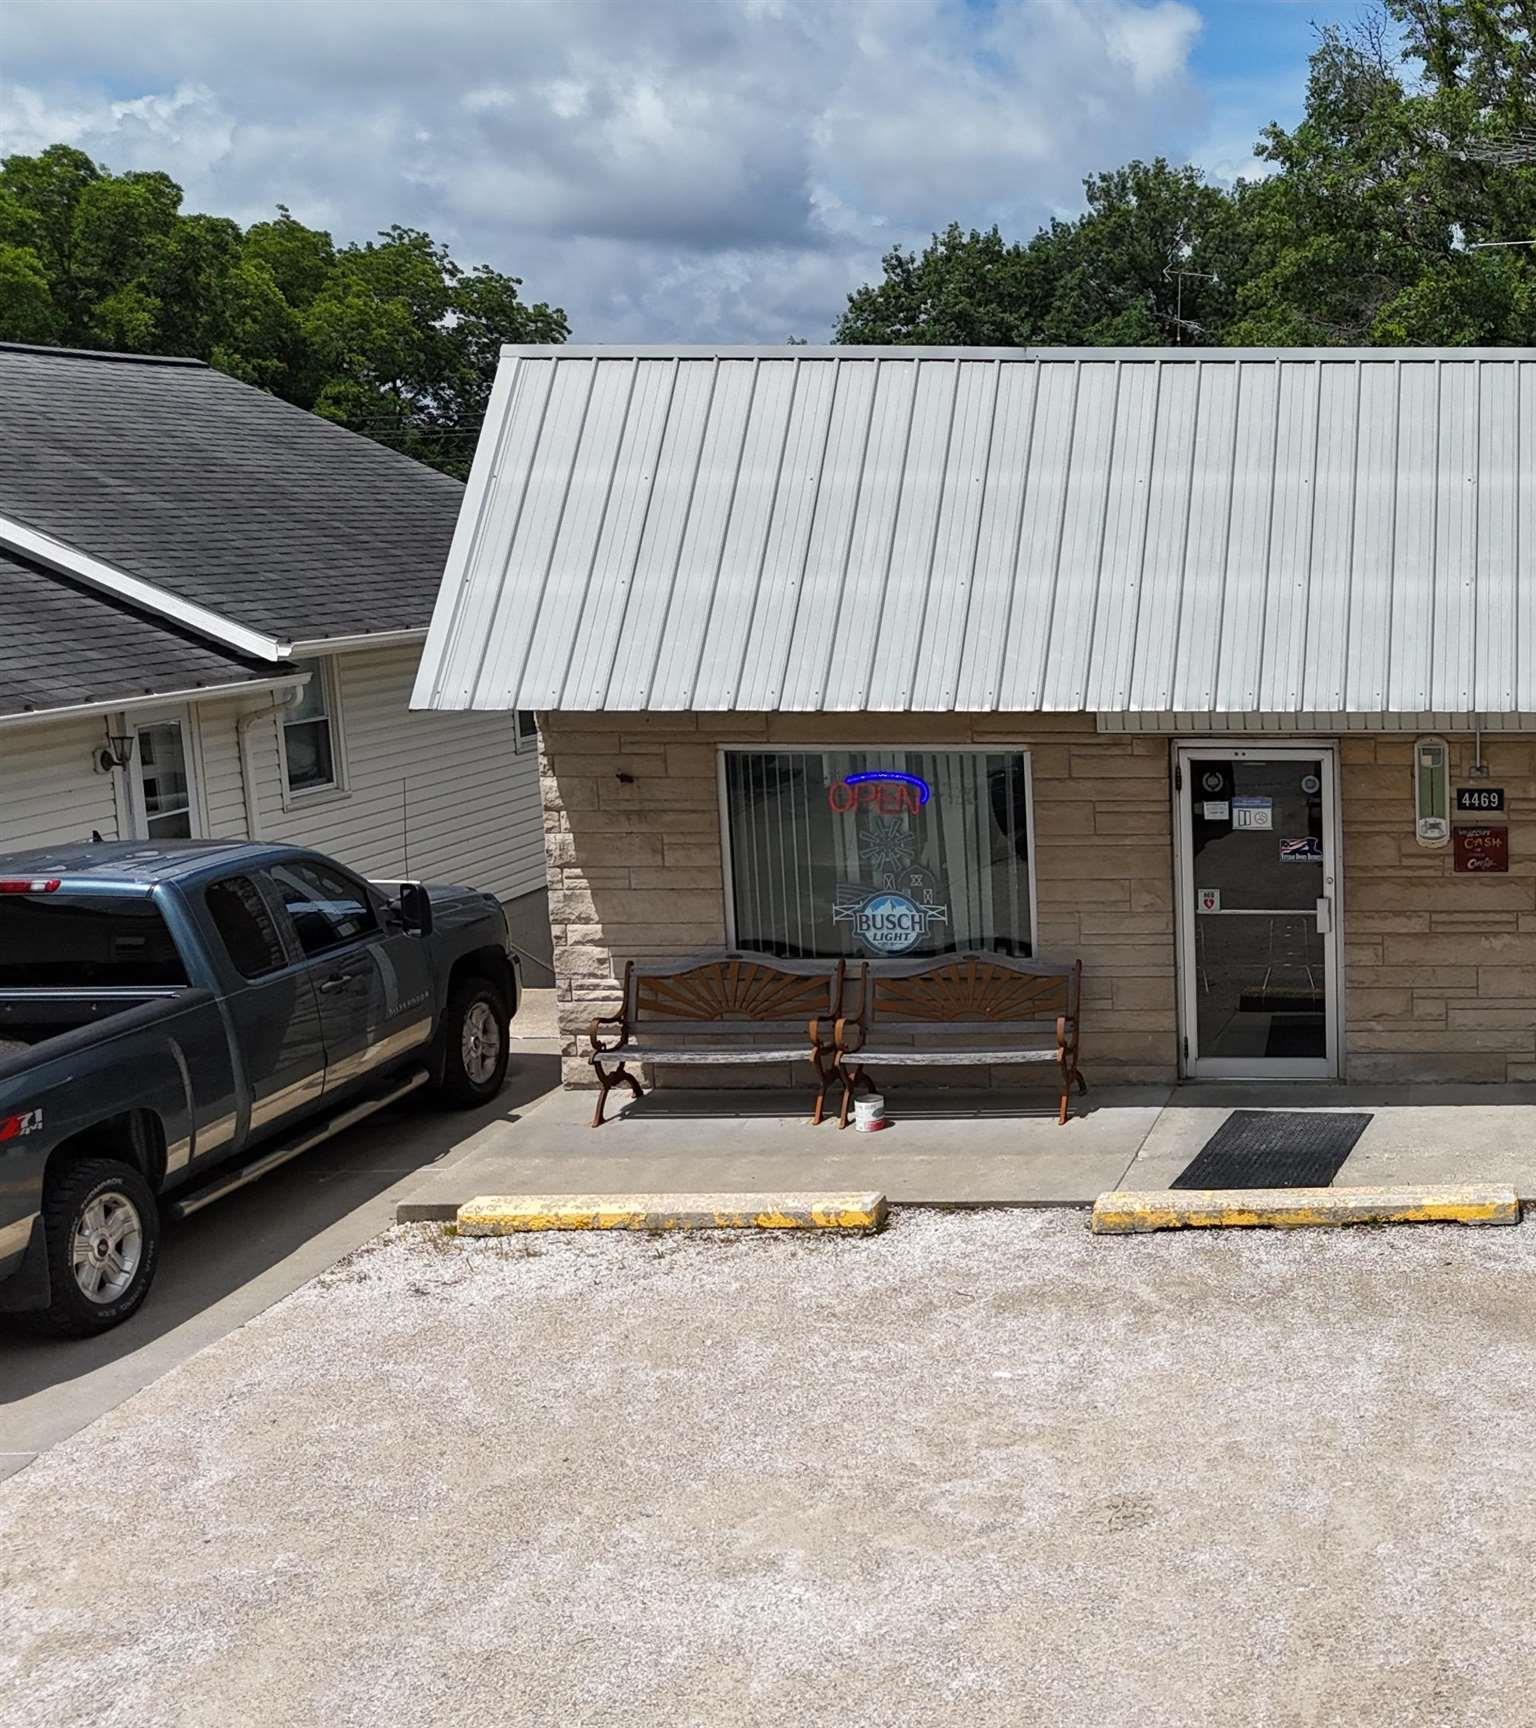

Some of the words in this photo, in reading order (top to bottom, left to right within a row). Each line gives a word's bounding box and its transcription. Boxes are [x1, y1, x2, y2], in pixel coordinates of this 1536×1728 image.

[828, 781, 922, 814] OPEN
[1461, 792, 1499, 808] 4469
[1464, 837, 1502, 849] CASH
[859, 912, 923, 932] BUSCH
[872, 931, 912, 942] LIGHT
